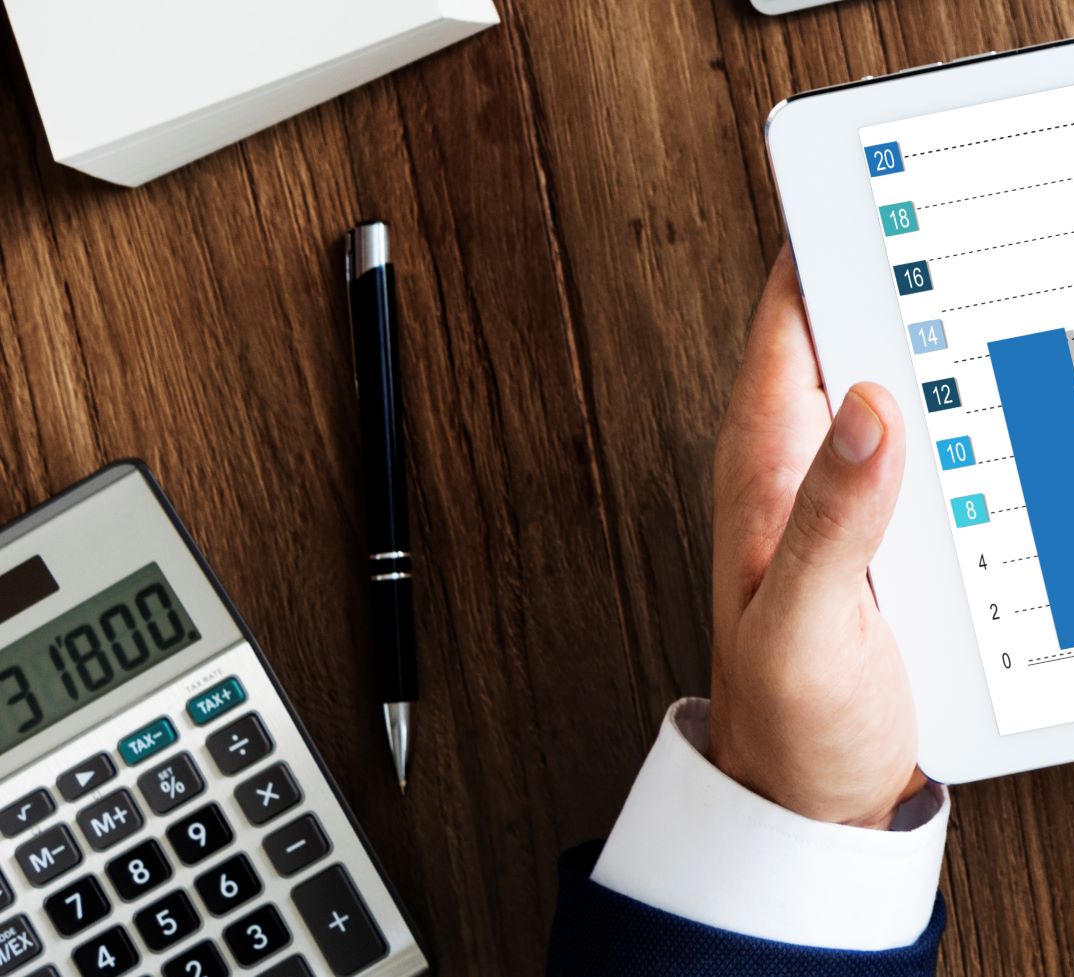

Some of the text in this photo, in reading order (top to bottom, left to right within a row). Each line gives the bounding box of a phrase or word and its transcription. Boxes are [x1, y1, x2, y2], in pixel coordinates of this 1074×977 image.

[873, 148, 896, 172] 20
[889, 208, 910, 231] 18
[903, 267, 924, 290] 16
[918, 325, 938, 349] 14
[932, 383, 953, 407] 12
[946, 441, 967, 464] 10
[965, 500, 977, 521] 8
[978, 553, 988, 572] 4
[989, 603, 1001, 622] 2
[1002, 652, 1012, 670] 0
[197, 688, 232, 716] TAX+
[157, 766, 174, 781] SET
[159, 775, 186, 800] %
[90, 805, 128, 838] M+
[187, 822, 206, 848] 9
[28, 844, 65, 873] M-
[128, 858, 150, 885] 8
[220, 873, 238, 898] 6
[64, 892, 83, 920] 7
[155, 909, 178, 935] 5
[246, 924, 268, 950] 3
[97, 944, 116, 968] 4
